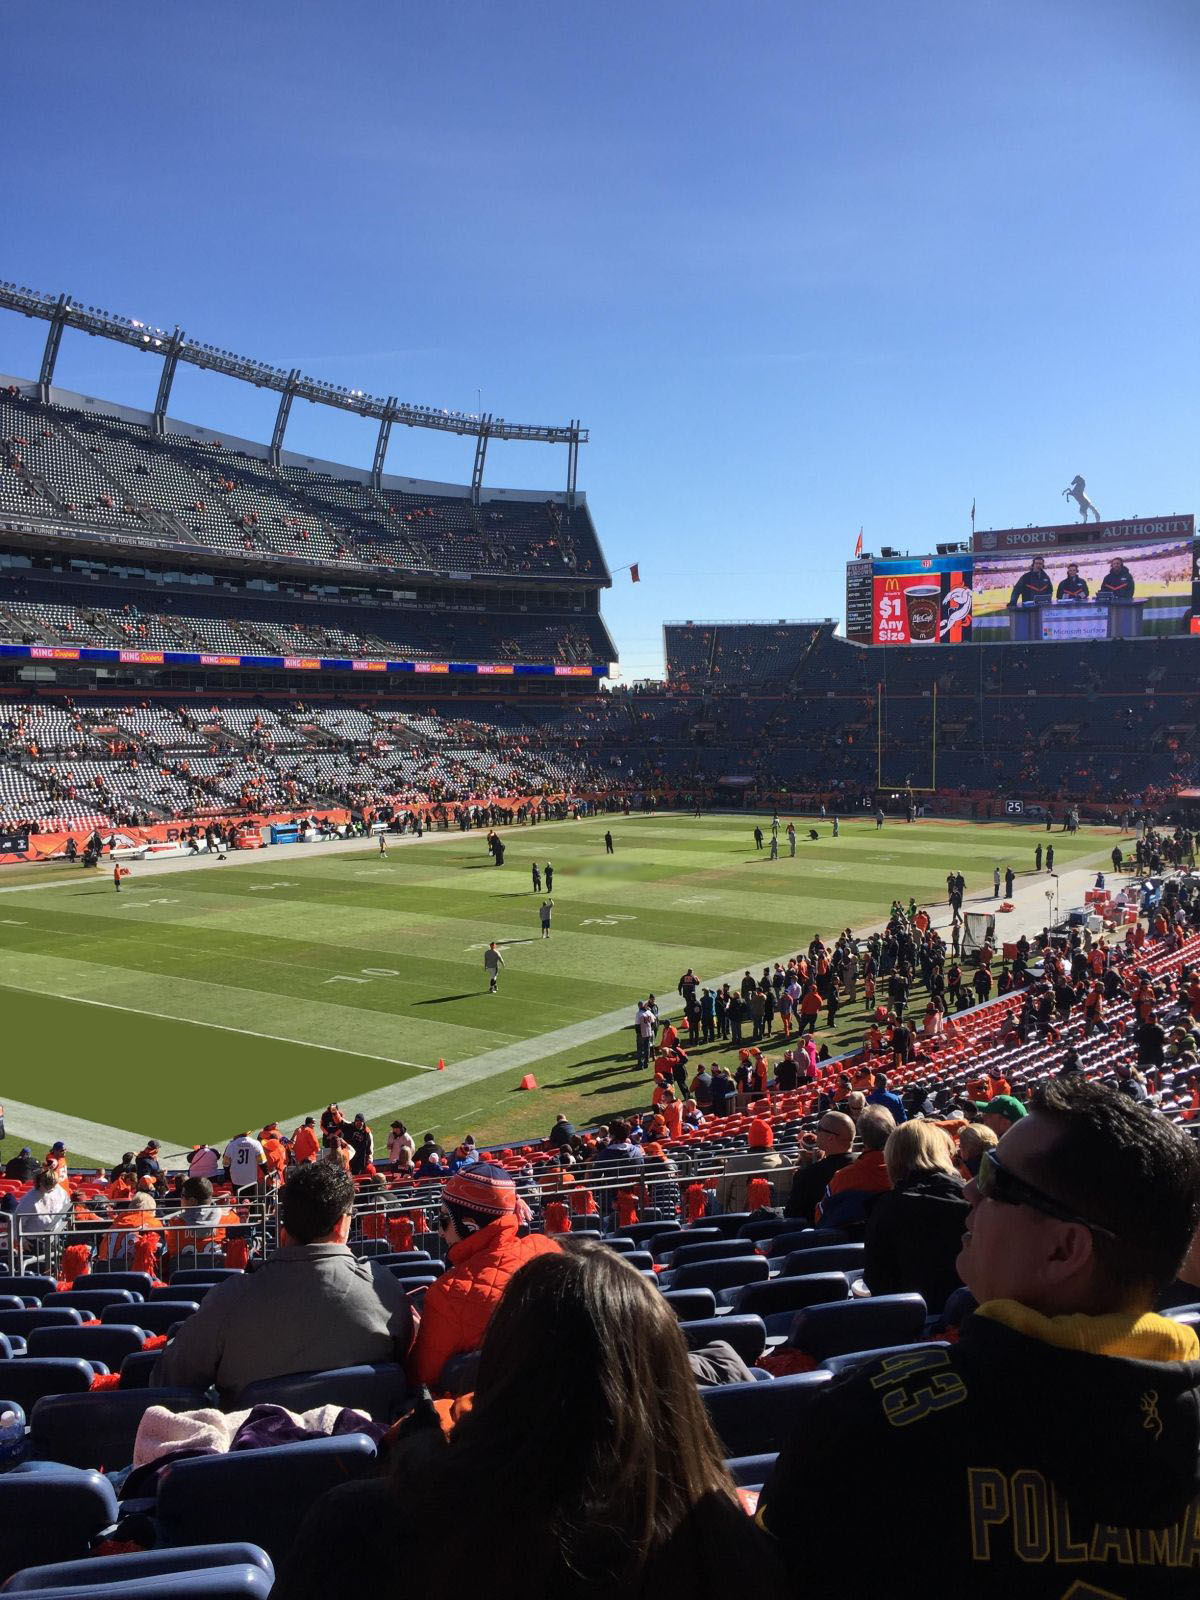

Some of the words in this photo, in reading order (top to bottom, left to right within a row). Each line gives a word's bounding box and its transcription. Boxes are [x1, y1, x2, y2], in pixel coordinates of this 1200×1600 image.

[34, 527, 58, 536] TURNER
[1006, 531, 1056, 545] SPORTS
[1102, 520, 1191, 538] AUTHORITY
[138, 540, 157, 548] MOSES
[880, 597, 901, 618] $1
[879, 619, 903, 630] Any
[879, 630, 905, 641] Size
[32, 649, 53, 657] KING
[122, 652, 140, 660] KING
[202, 656, 218, 664] KING
[286, 658, 300, 667] KING
[416, 664, 430, 672] KING
[321, 968, 400, 984] 10
[237, 1149, 249, 1164] 31
[870, 1350, 968, 1426] 43
